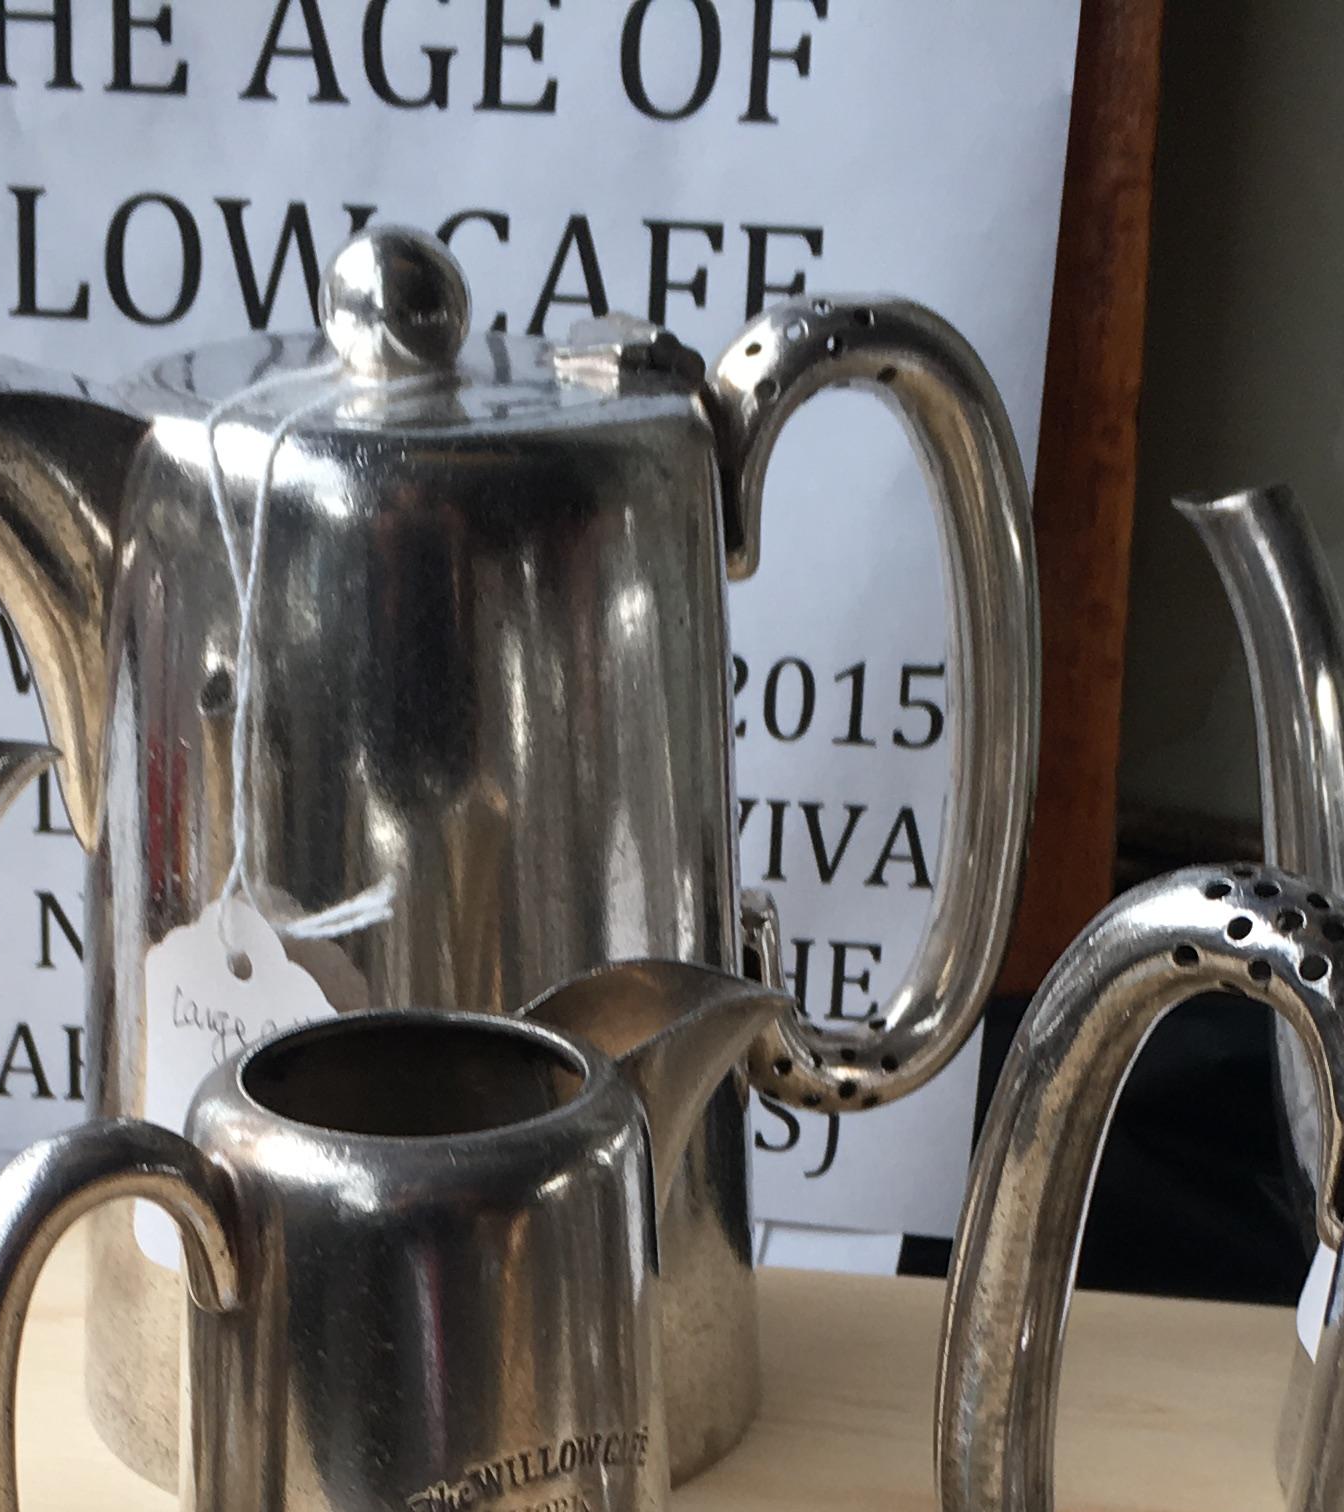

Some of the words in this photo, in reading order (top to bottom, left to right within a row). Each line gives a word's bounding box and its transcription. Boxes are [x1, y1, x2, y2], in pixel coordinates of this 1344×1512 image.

[239, 0, 559, 116] AGE
[619, 0, 828, 124] OF
[464, 1432, 603, 1500] WILLOW
